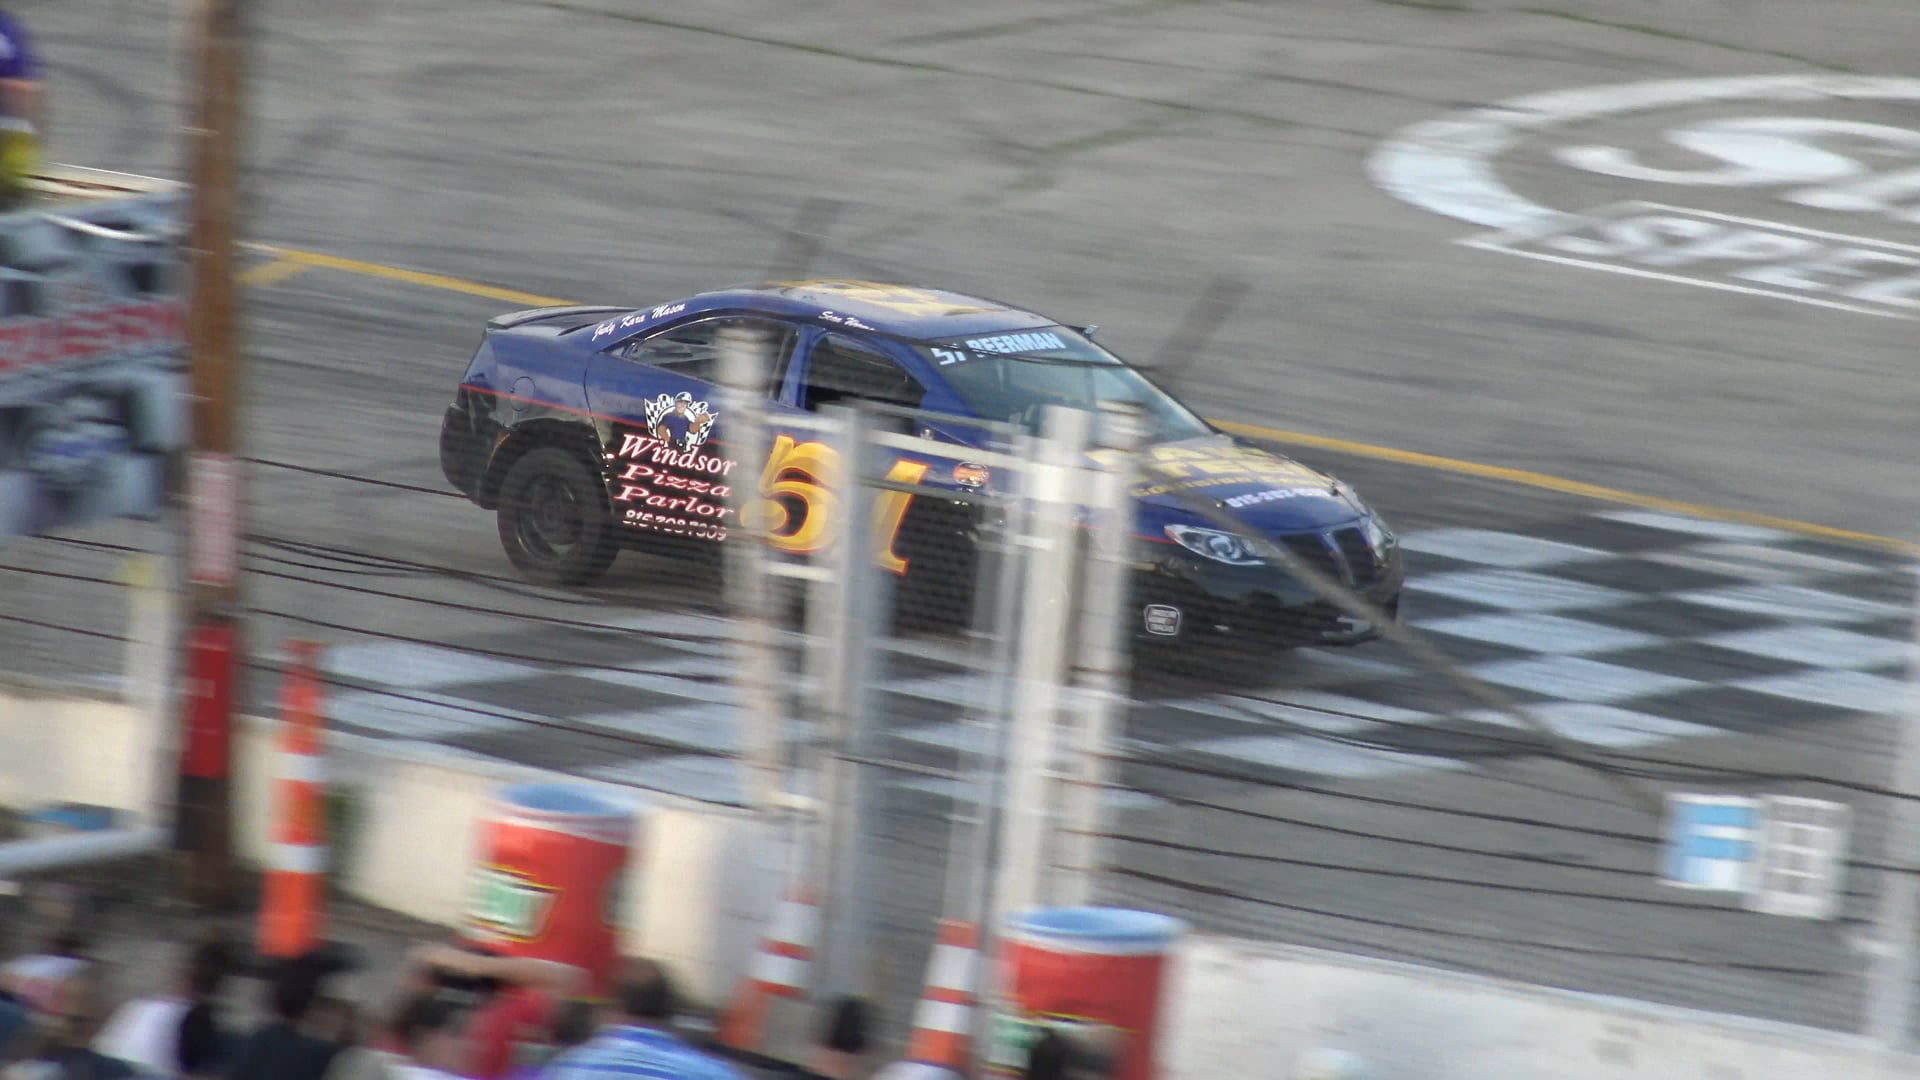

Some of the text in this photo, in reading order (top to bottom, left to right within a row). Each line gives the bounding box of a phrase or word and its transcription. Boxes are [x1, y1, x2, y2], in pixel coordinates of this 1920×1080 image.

[618, 433, 737, 476] Windsor
[617, 463, 732, 497] Pizza
[613, 484, 735, 519] Parlor
[739, 433, 932, 576] 51
